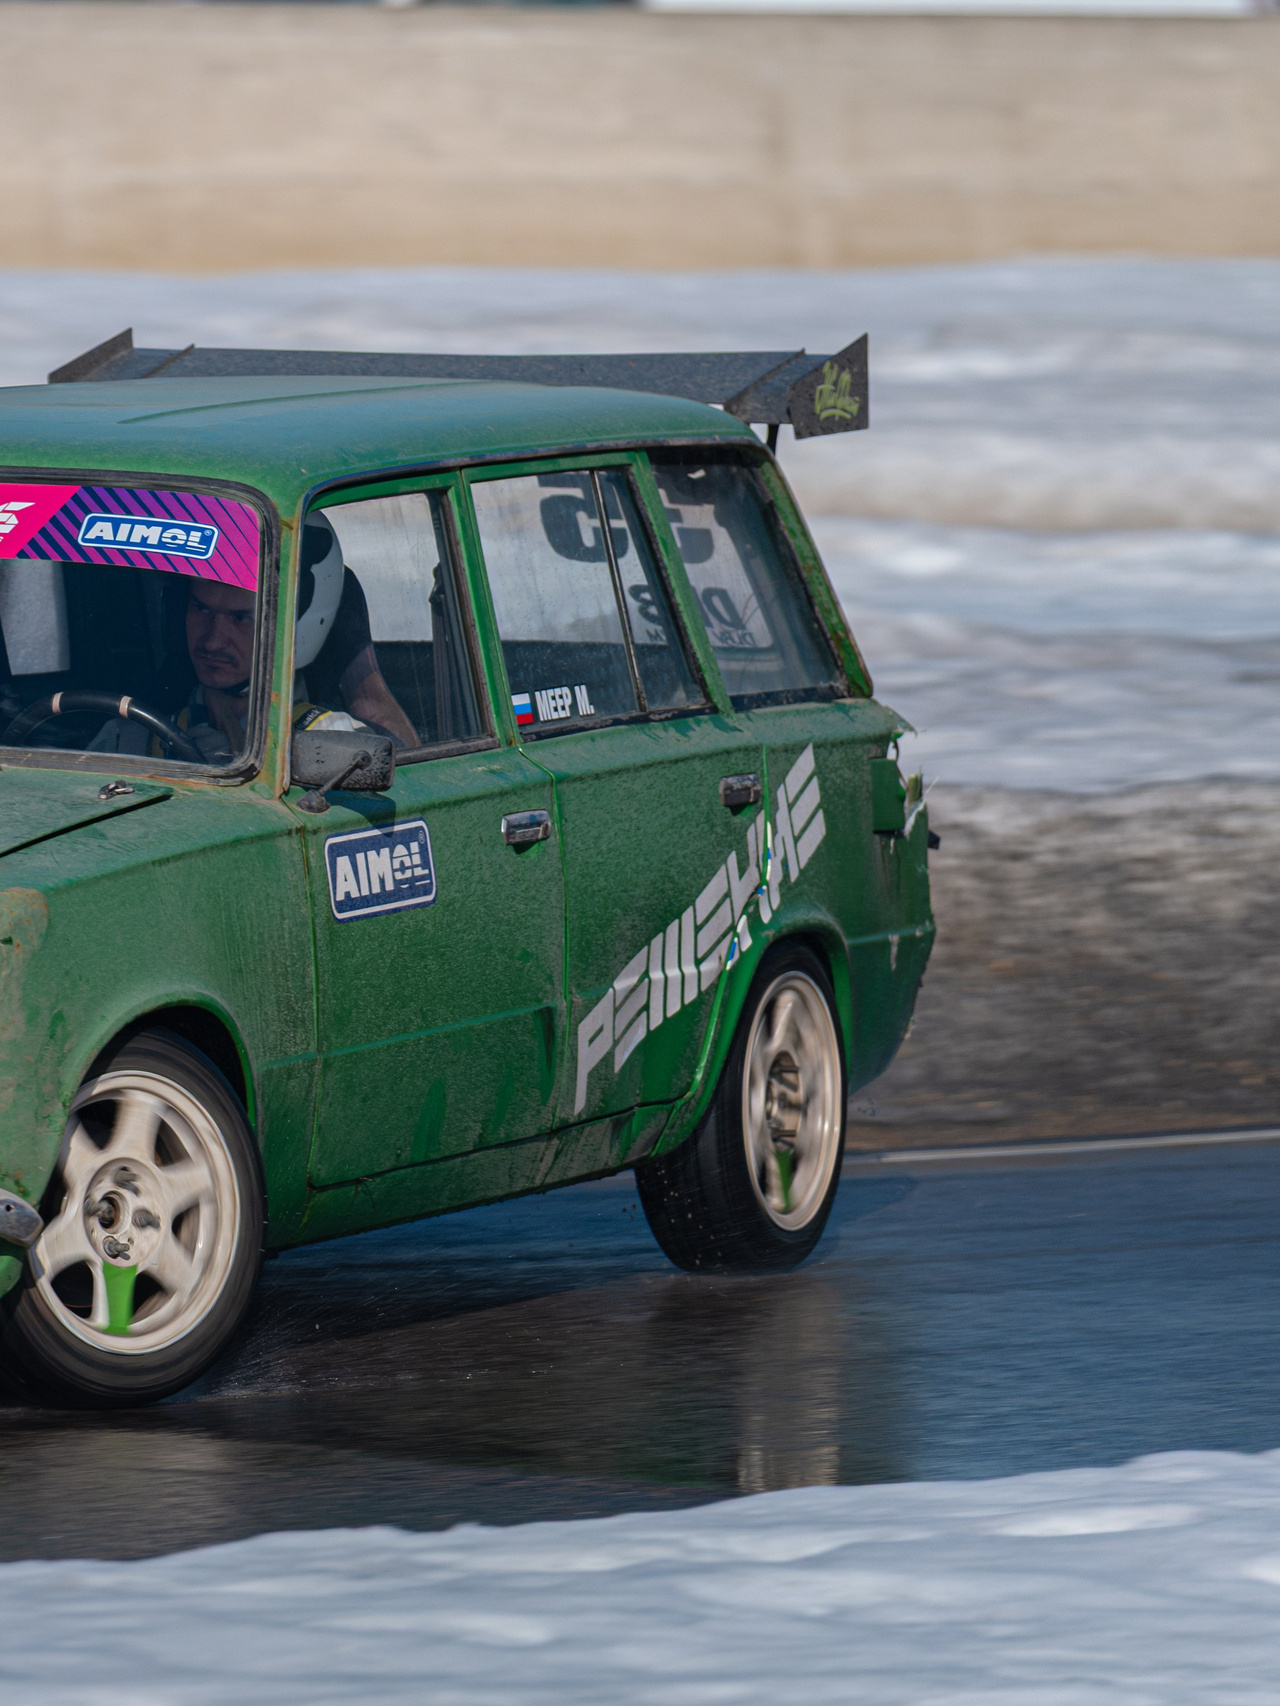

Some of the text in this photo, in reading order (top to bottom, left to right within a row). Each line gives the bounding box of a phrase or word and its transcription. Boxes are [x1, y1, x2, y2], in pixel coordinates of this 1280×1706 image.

[84, 520, 208, 555] AIMOL
[534, 686, 572, 722] МЕЕР
[335, 841, 430, 901] AIMOL
